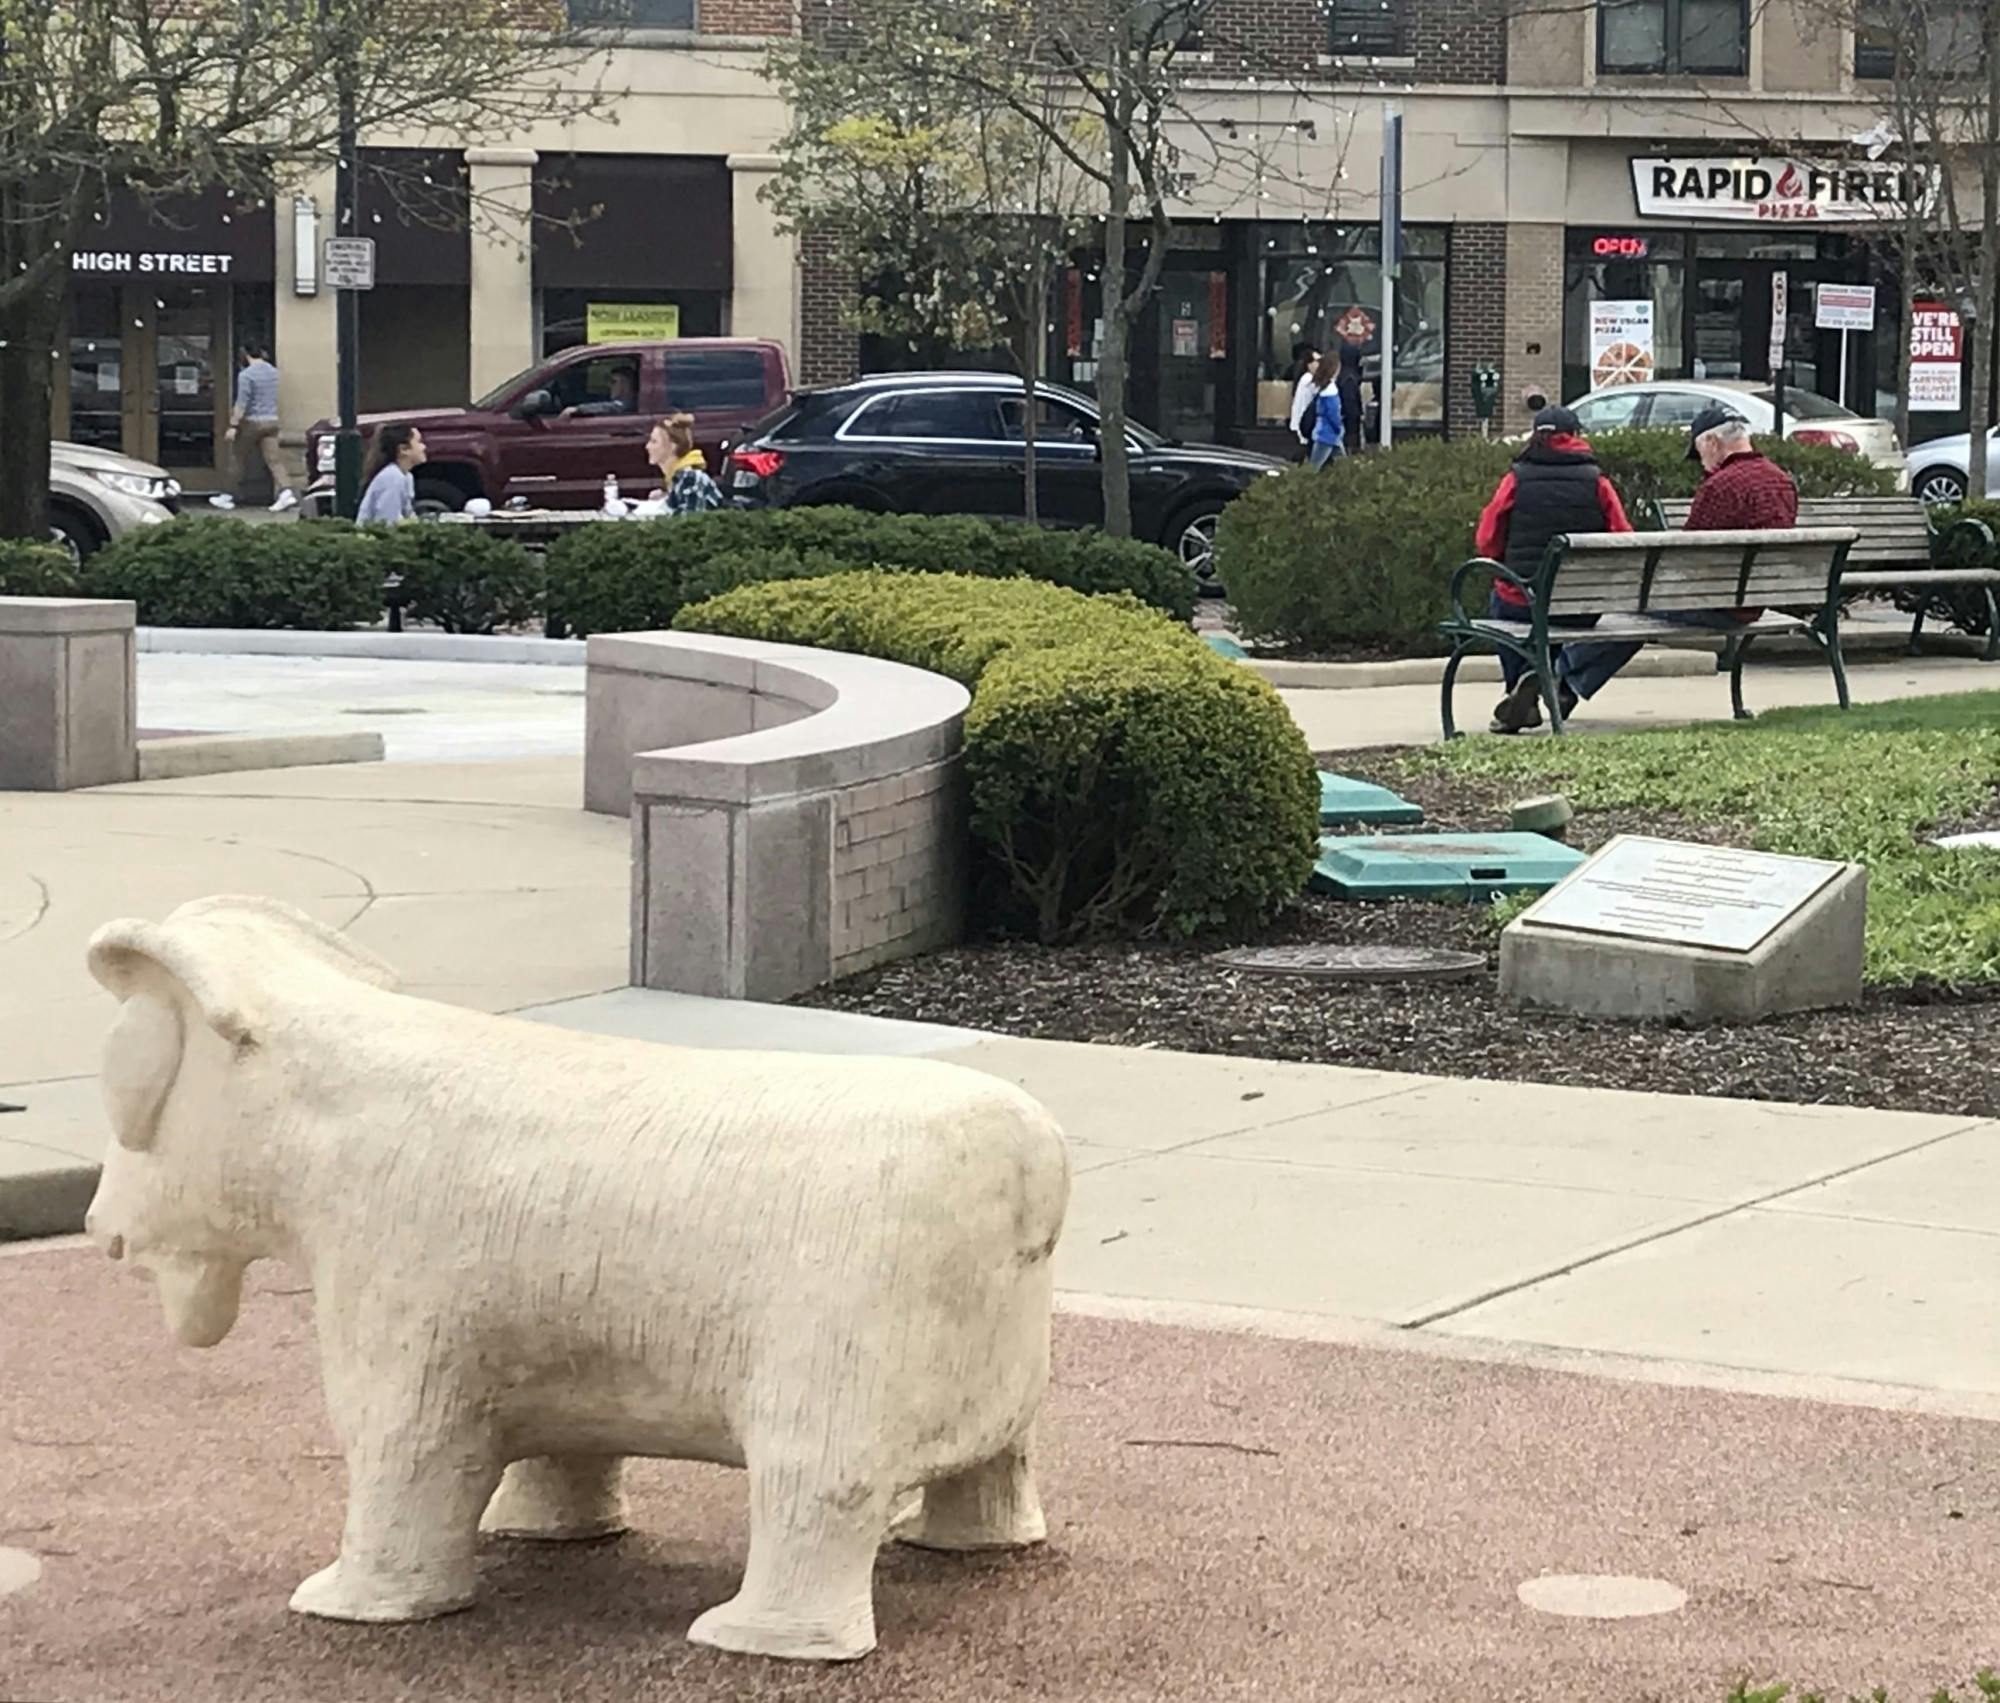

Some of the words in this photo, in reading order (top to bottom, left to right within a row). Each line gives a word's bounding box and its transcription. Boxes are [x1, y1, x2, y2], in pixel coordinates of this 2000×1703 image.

[1652, 165, 1772, 201] RAPID
[1758, 203, 1819, 219] PIZZA
[1594, 238, 1648, 257] OPEN
[72, 252, 131, 271] HIGH
[138, 253, 232, 273] STREET
[1911, 327, 1954, 341] STILL
[1909, 341, 1956, 356] OPEN
